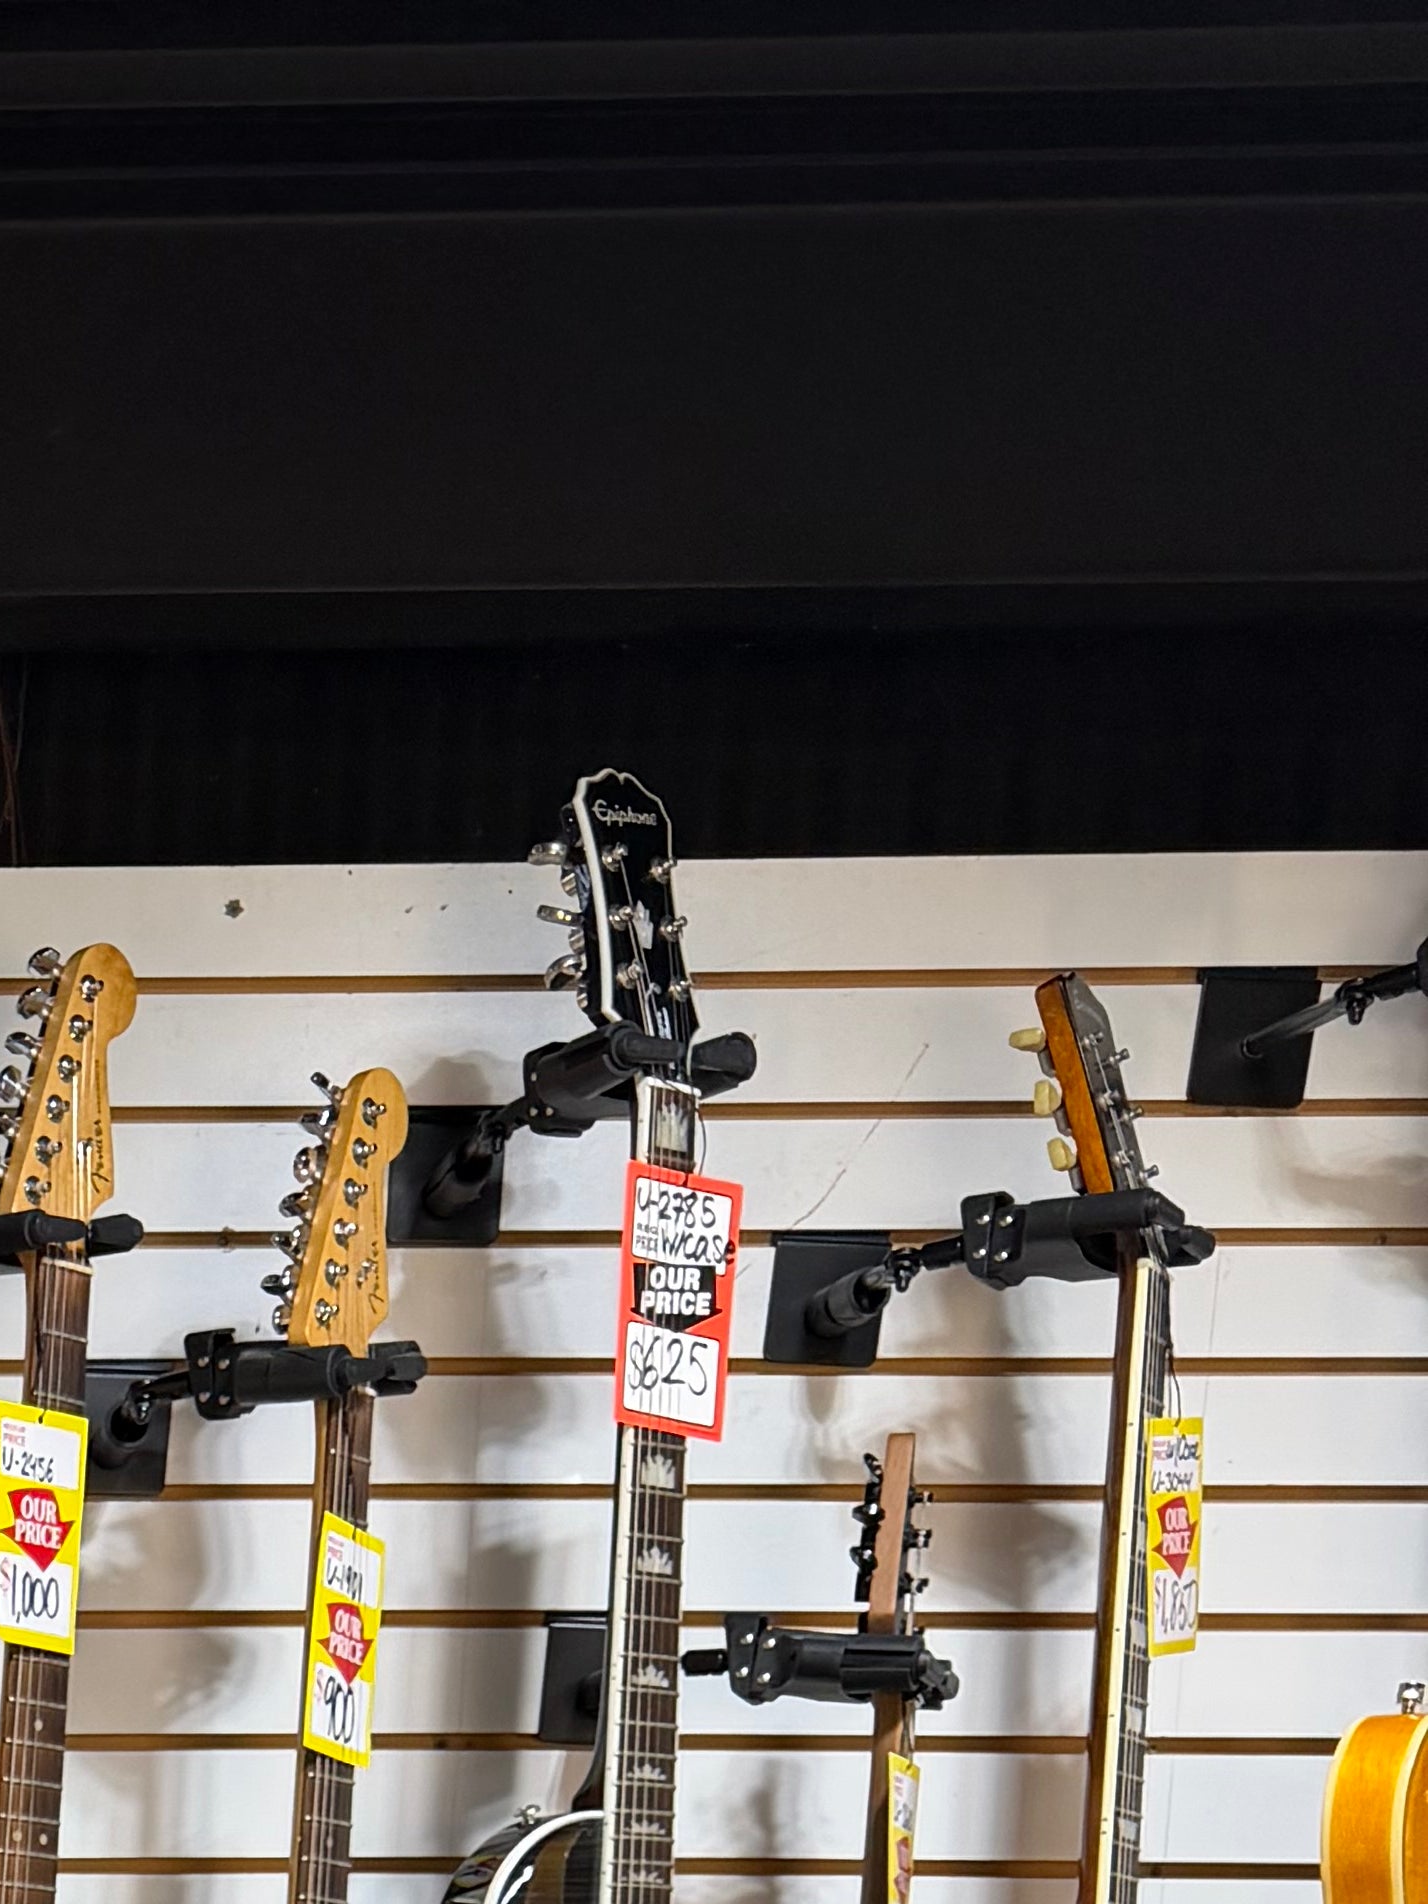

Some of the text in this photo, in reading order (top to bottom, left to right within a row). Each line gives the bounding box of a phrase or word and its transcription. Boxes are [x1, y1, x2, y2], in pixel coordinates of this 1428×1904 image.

[592, 799, 658, 828] Epiphone
[649, 1265, 702, 1292] OUR
[640, 1290, 713, 1318] PRICE
[627, 1335, 709, 1397] $625
[20, 1494, 58, 1525] OUR
[1164, 1507, 1189, 1532] OUR
[14, 1519, 64, 1550] PRICE
[1162, 1531, 1192, 1557] PRICE
[0, 1556, 60, 1624] $1,000
[334, 1609, 362, 1641] OUR
[328, 1632, 365, 1667] PRICE
[315, 1668, 356, 1745] $900
